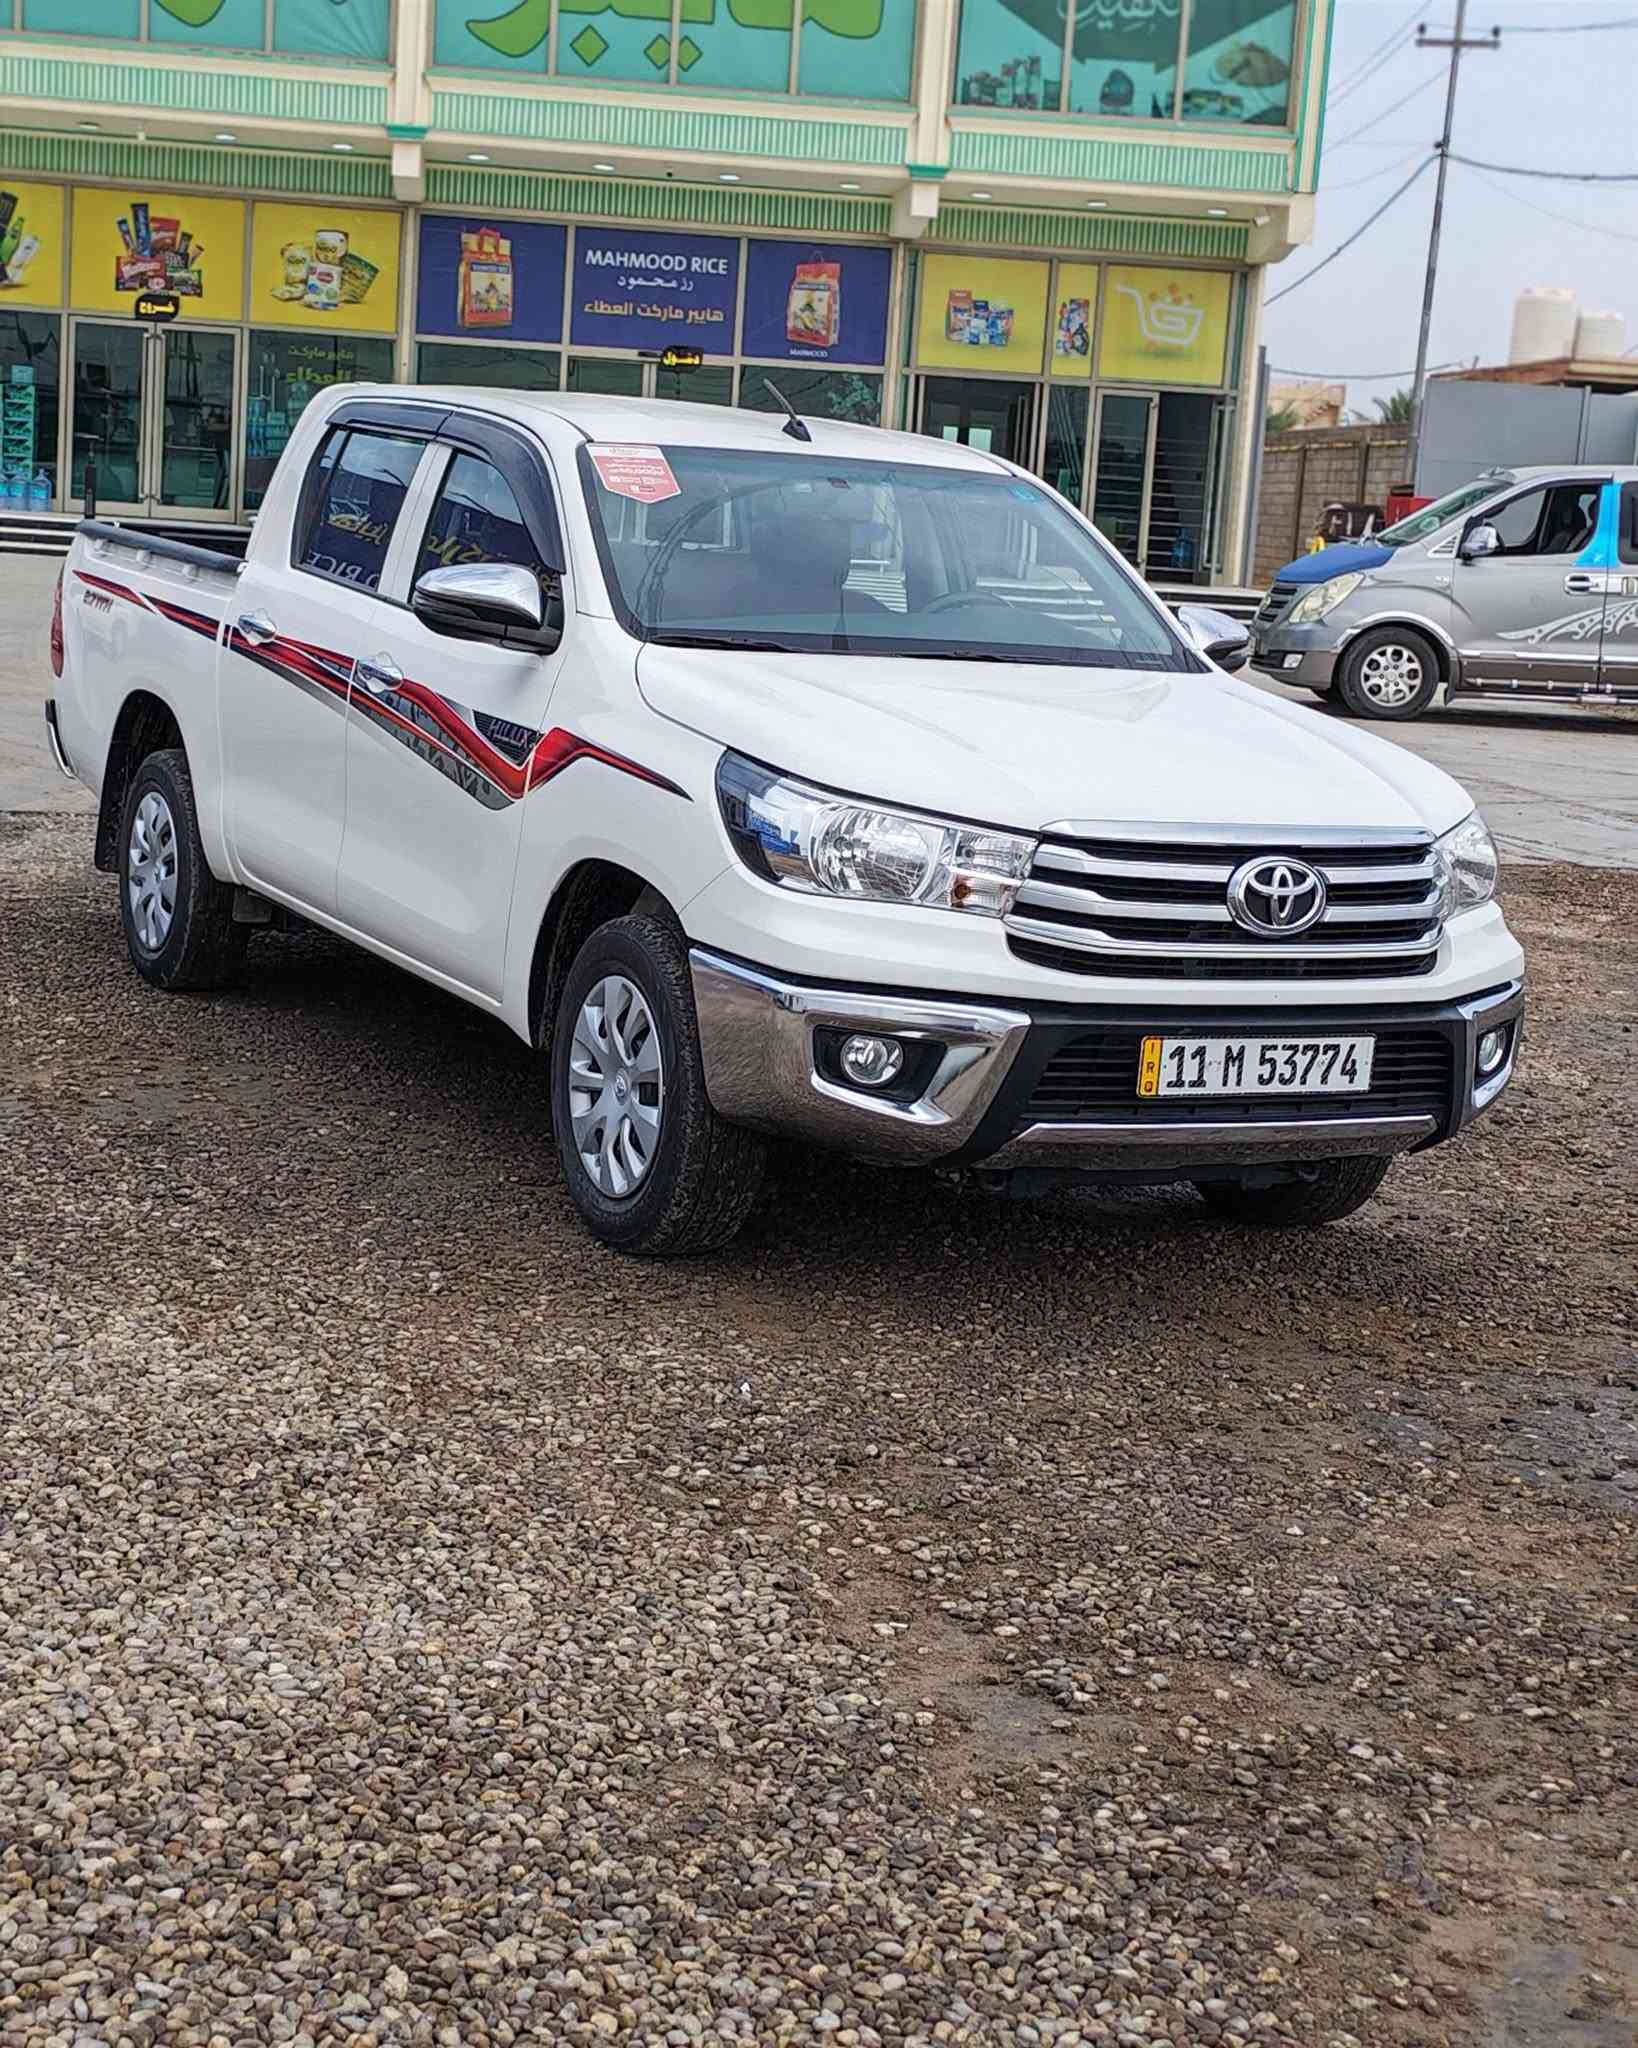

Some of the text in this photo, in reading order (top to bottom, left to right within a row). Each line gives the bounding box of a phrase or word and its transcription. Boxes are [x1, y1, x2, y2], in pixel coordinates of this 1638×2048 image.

[585, 249, 729, 275] MAHMOOD RICE
[617, 274, 694, 291] رز محمود
[583, 300, 725, 325] هايبر ماركت العطاء
[487, 719, 533, 749] HILUX
[1166, 1043, 1358, 1087] 11 M 53774
